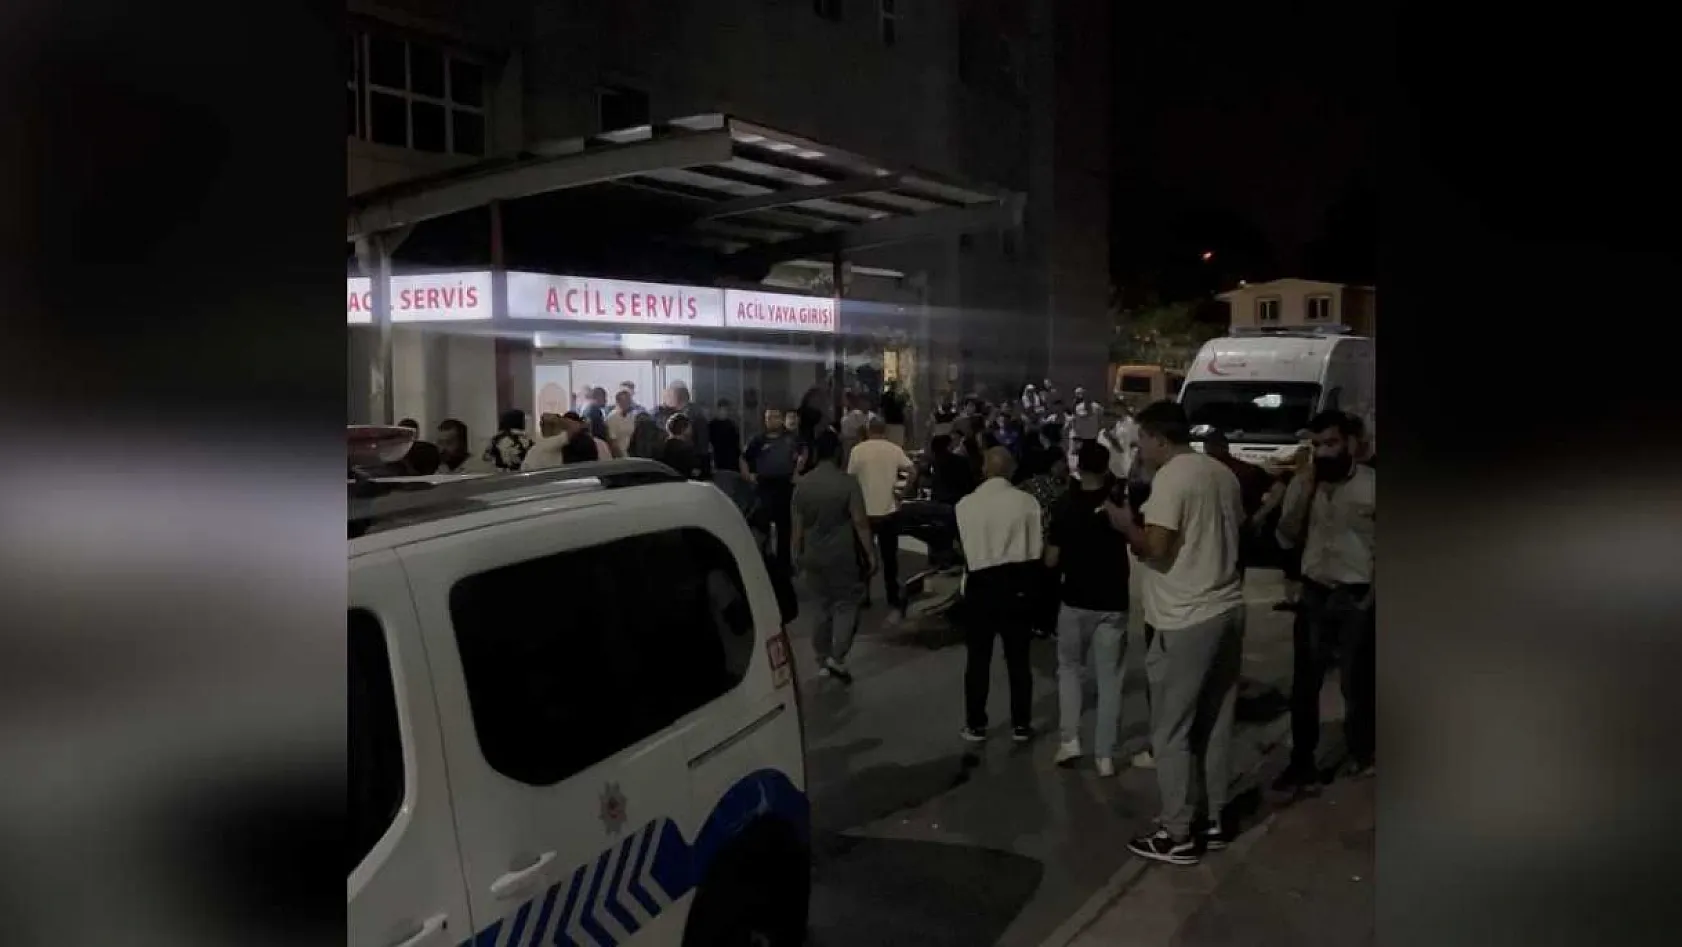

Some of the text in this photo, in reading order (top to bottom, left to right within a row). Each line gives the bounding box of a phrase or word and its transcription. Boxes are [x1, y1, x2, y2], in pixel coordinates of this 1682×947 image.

[400, 280, 478, 310] SERVİS
[546, 283, 697, 319] ACİL SERVİS
[737, 299, 765, 321] ACİL
[767, 304, 797, 324] YAYA
